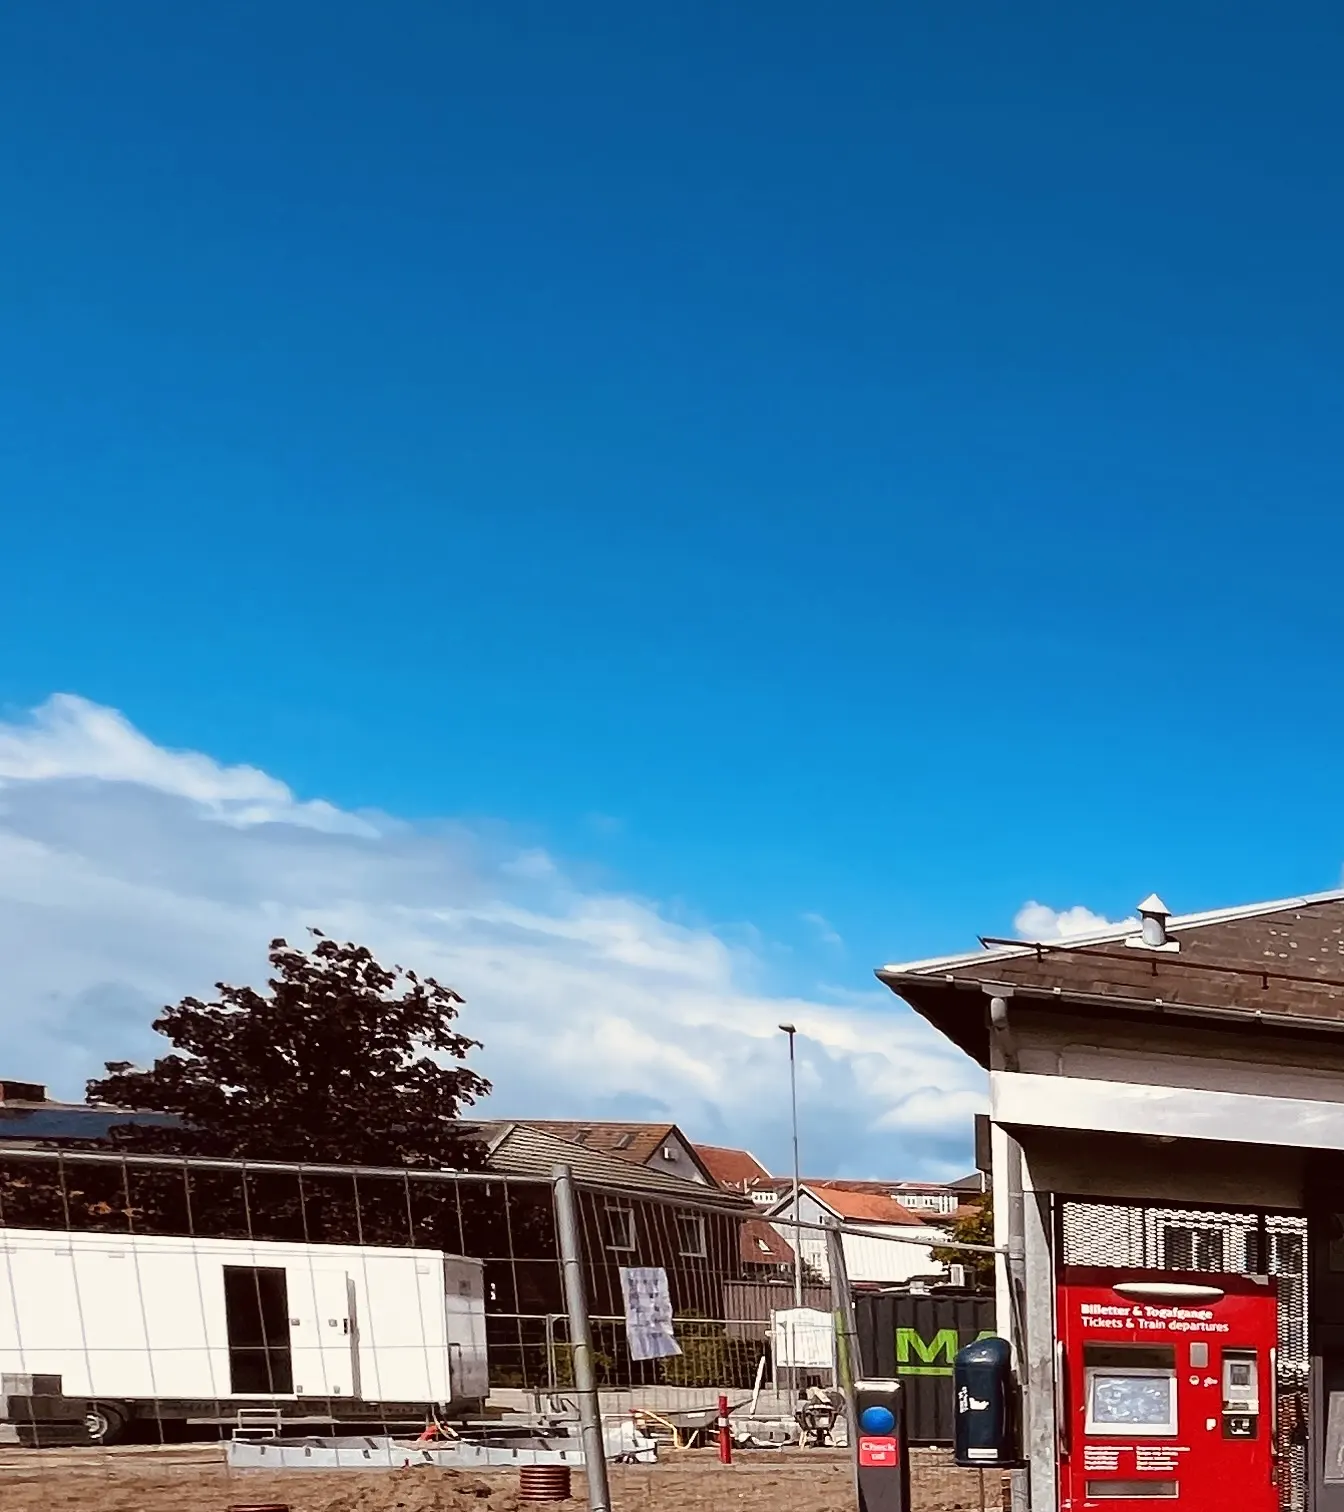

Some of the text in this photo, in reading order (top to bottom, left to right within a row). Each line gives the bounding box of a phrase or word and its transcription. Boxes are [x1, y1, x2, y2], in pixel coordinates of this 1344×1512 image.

[1080, 1304, 1130, 1316] Billetter
[1132, 1306, 1143, 1316] &
[1081, 1316, 1230, 1332] Tickets & Train departures
[861, 1442, 896, 1451] Check
